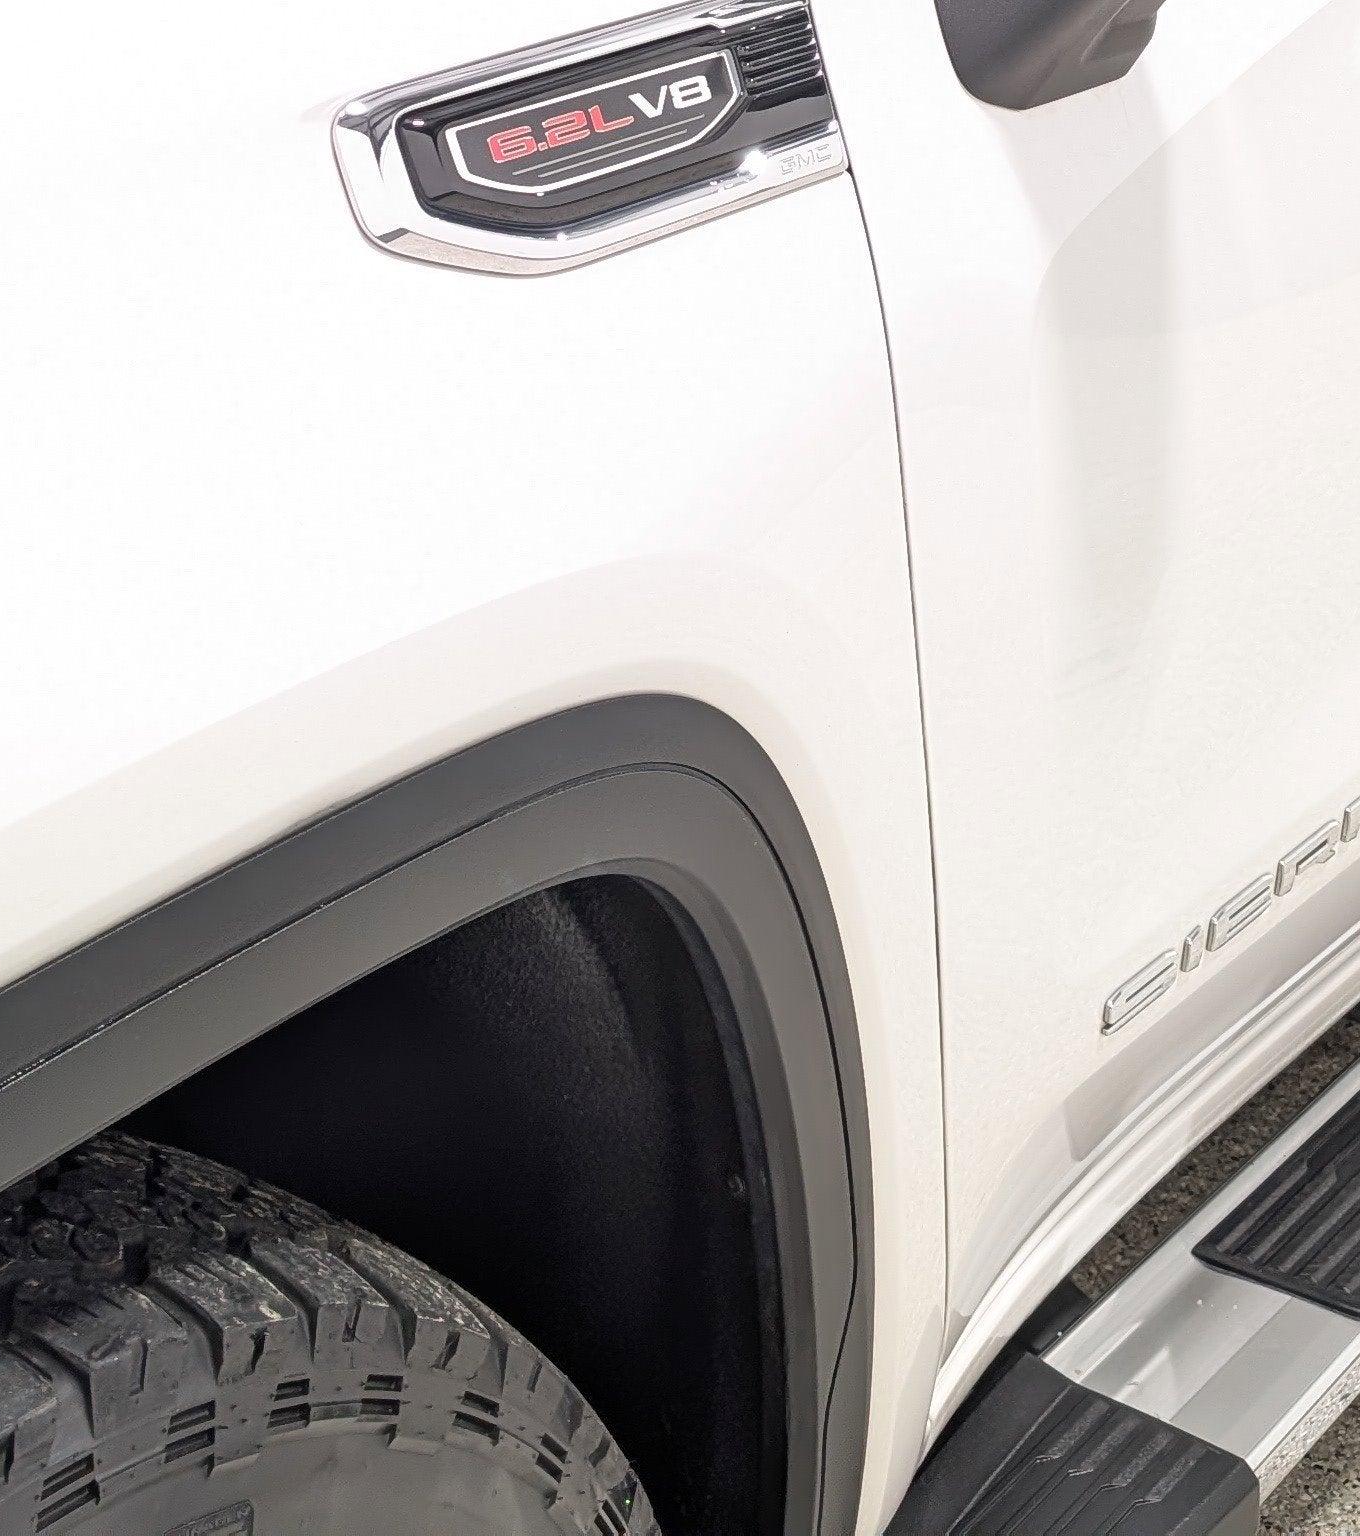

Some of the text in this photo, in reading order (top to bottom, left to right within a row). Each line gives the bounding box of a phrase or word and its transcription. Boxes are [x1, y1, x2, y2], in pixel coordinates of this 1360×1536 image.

[486, 75, 713, 164] 6.2L V8
[780, 143, 832, 175] GMC
